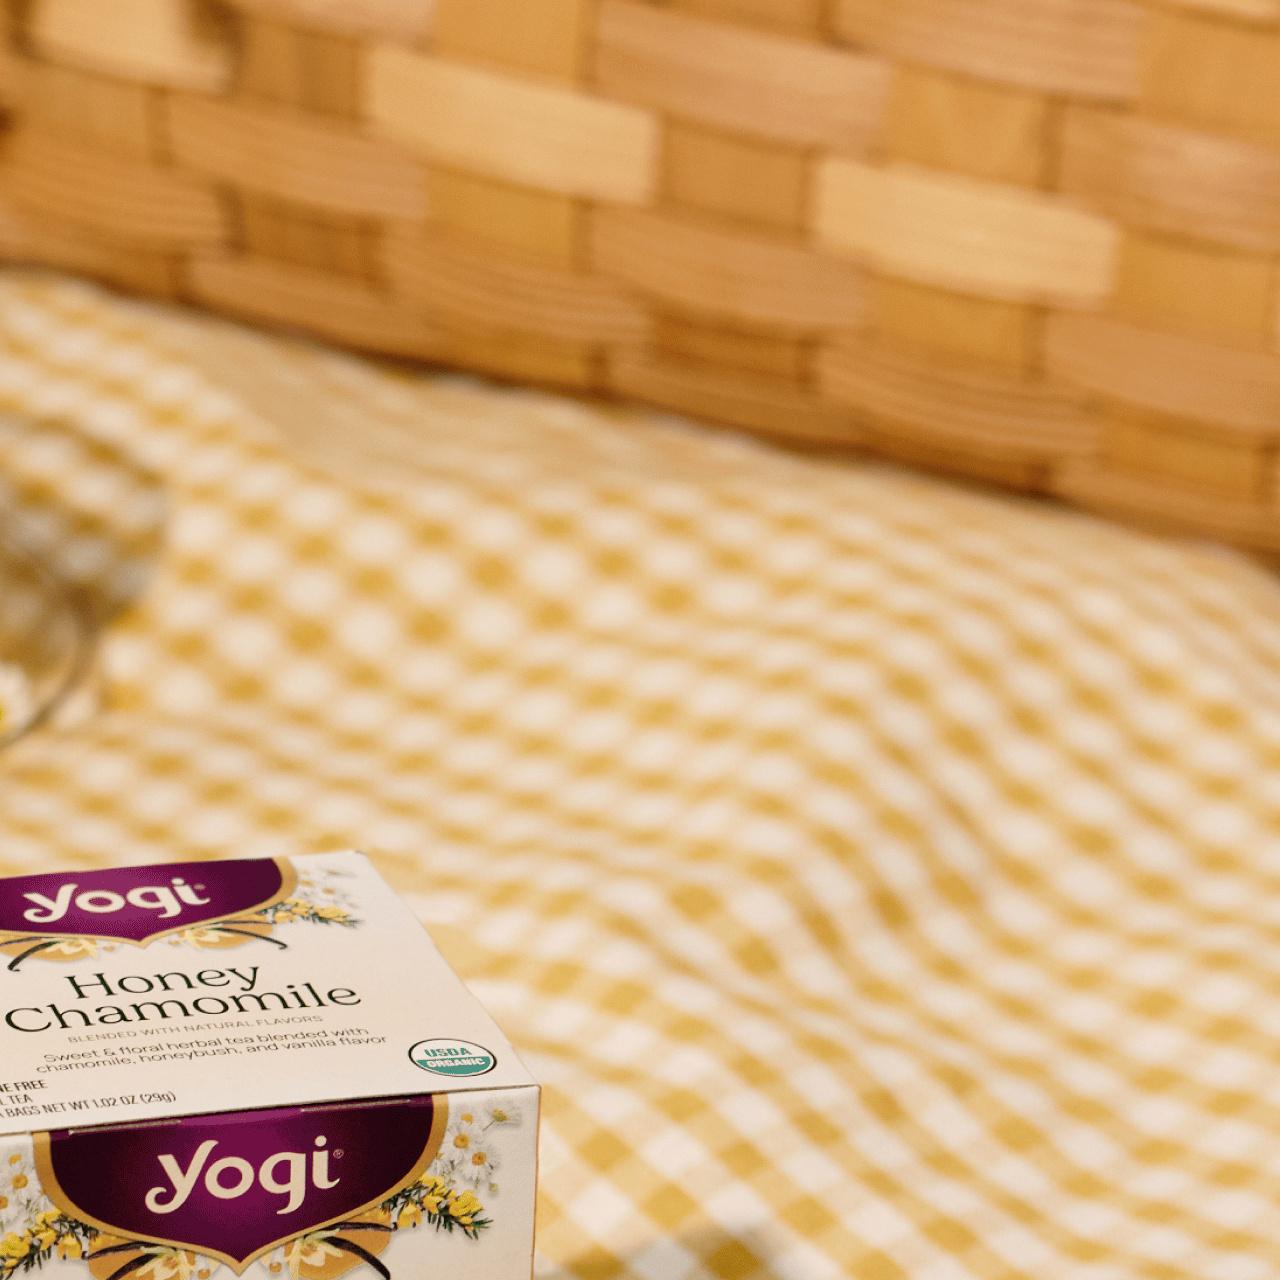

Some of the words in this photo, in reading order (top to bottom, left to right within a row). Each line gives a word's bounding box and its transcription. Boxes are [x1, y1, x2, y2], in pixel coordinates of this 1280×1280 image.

[64, 966, 259, 998] Honey
[5, 982, 361, 1032] Chamomile
[68, 1030, 137, 1043] BLENDED
[140, 1027, 180, 1036] WITH
[184, 1020, 255, 1032] NATURAL
[256, 1015, 323, 1026] FLAVORS
[43, 1050, 102, 1062] Sweet
[120, 1043, 163, 1054] floral
[167, 1037, 221, 1050] herbal
[226, 1037, 254, 1045] tea
[256, 1030, 328, 1042] blended
[330, 1027, 369, 1037] with
[246, 1043, 278, 1053] and
[281, 1039, 336, 1050] vanilla
[339, 1036, 387, 1045] flavor
[424, 1047, 472, 1056] USDA
[427, 1058, 485, 1067] ORGANIC
[14, 1079, 48, 1092] FREE
[6, 1107, 41, 1117] BAGS
[44, 1103, 68, 1113] NET
[70, 1101, 91, 1111] WT
[93, 1098, 118, 1108] 1.02
[120, 1095, 138, 1106] OZ
[9, 1094, 33, 1104] TEA
